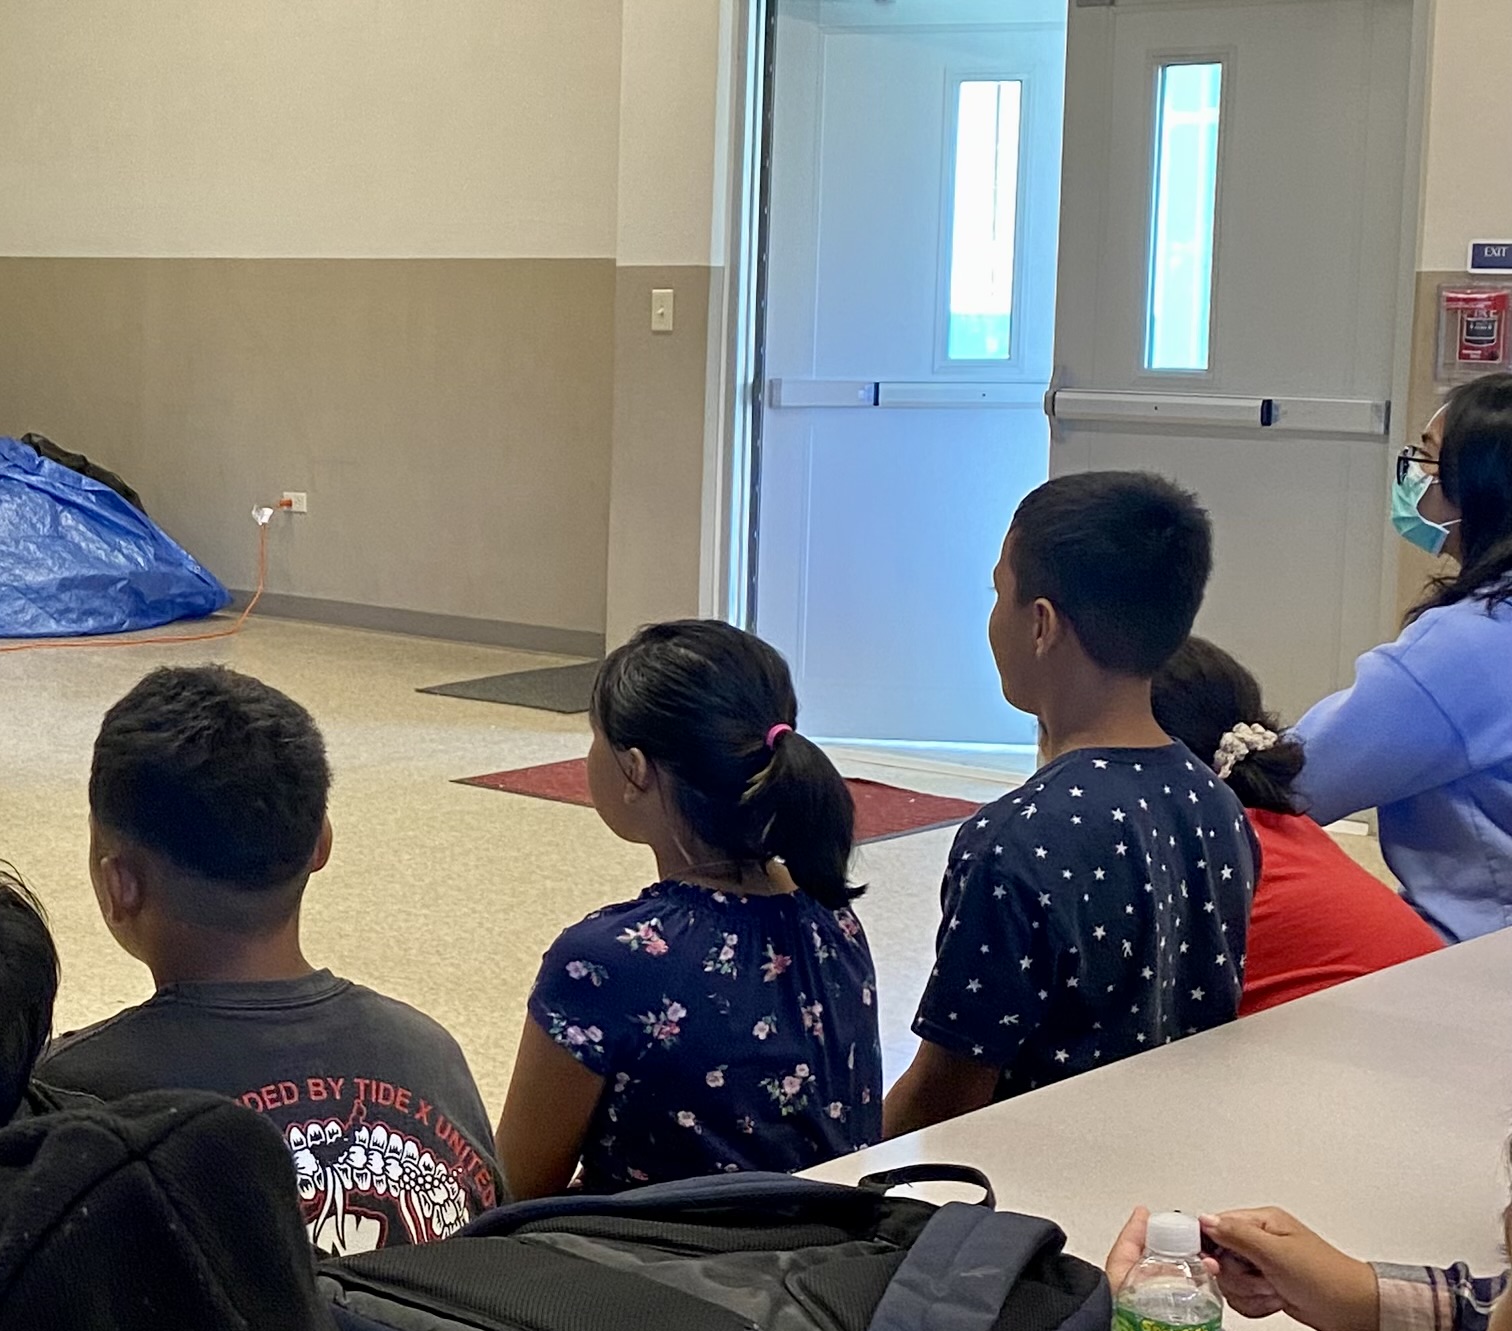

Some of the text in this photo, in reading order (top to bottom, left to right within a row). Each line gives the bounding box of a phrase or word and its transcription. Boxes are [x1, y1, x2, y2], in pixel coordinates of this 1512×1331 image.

[1484, 246, 1508, 257] EXIT
[233, 1081, 299, 1112] DED
[307, 1078, 345, 1101] BY
[354, 1078, 411, 1113] TIDE
[414, 1098, 433, 1126] X
